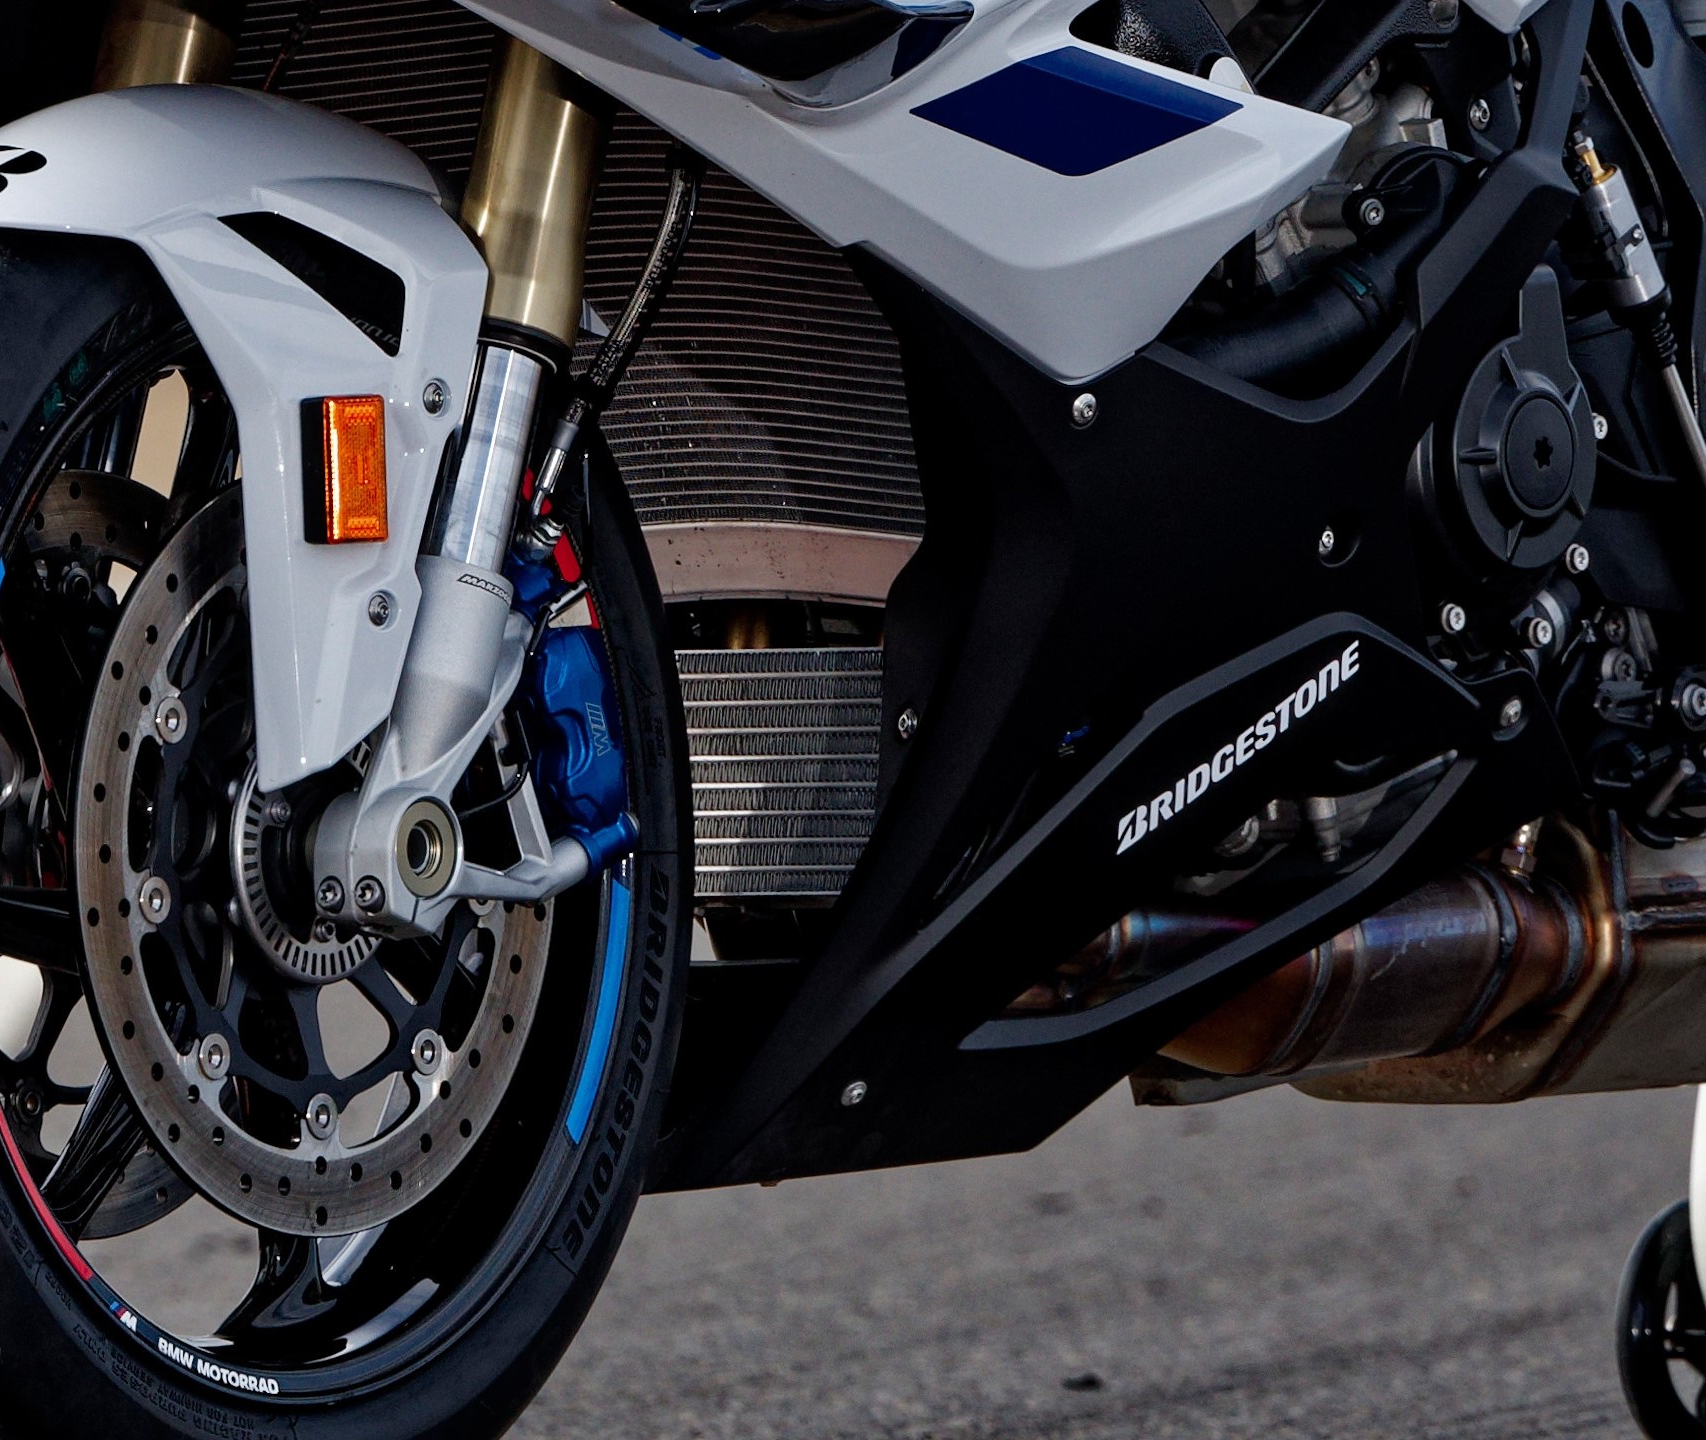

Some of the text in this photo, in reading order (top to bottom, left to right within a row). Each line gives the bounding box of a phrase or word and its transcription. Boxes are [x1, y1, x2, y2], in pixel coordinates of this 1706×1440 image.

[1116, 640, 1360, 855] BRIDGESTONE
[563, 863, 670, 1260] BRIDGESTONE
[157, 1336, 280, 1394] BMW MOTORRAD
